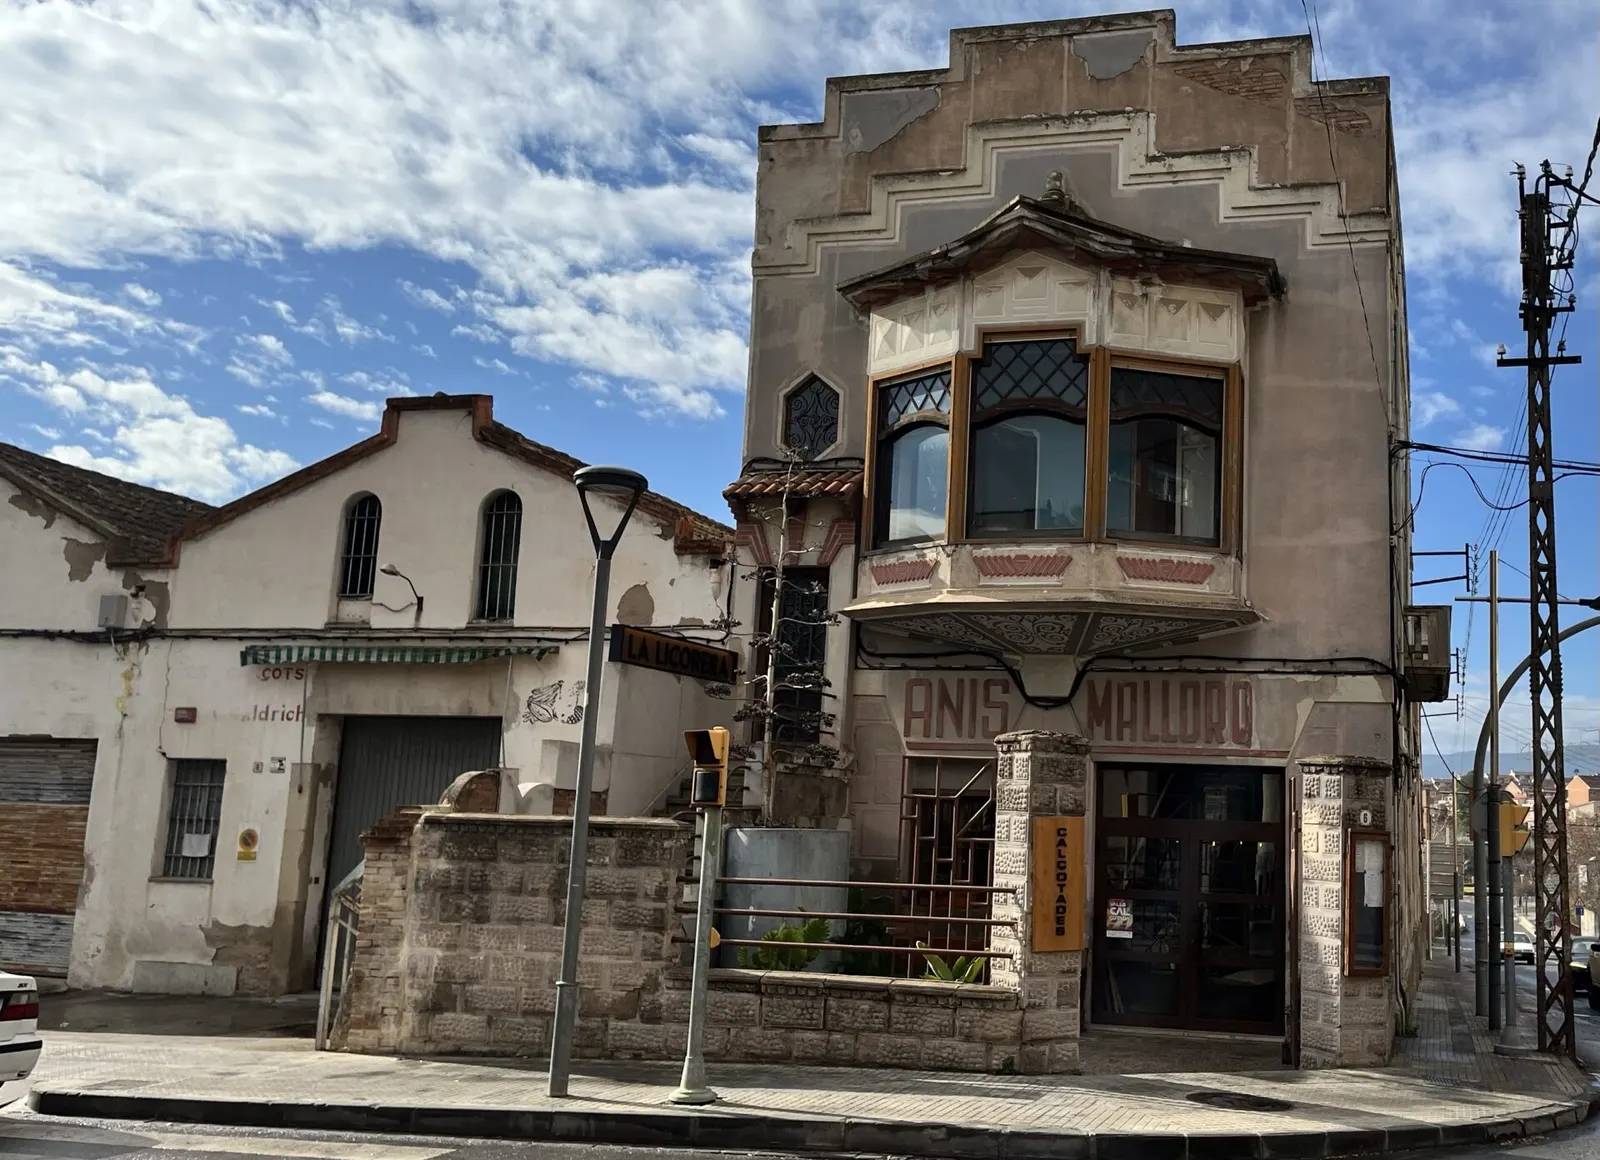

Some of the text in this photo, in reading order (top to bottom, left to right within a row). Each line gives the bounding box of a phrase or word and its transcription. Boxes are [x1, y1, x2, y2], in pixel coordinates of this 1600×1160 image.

[628, 634, 729, 678] LA LICORERA
[903, 677, 1012, 739] ANIS
[1363, 812, 1369, 823] 6
